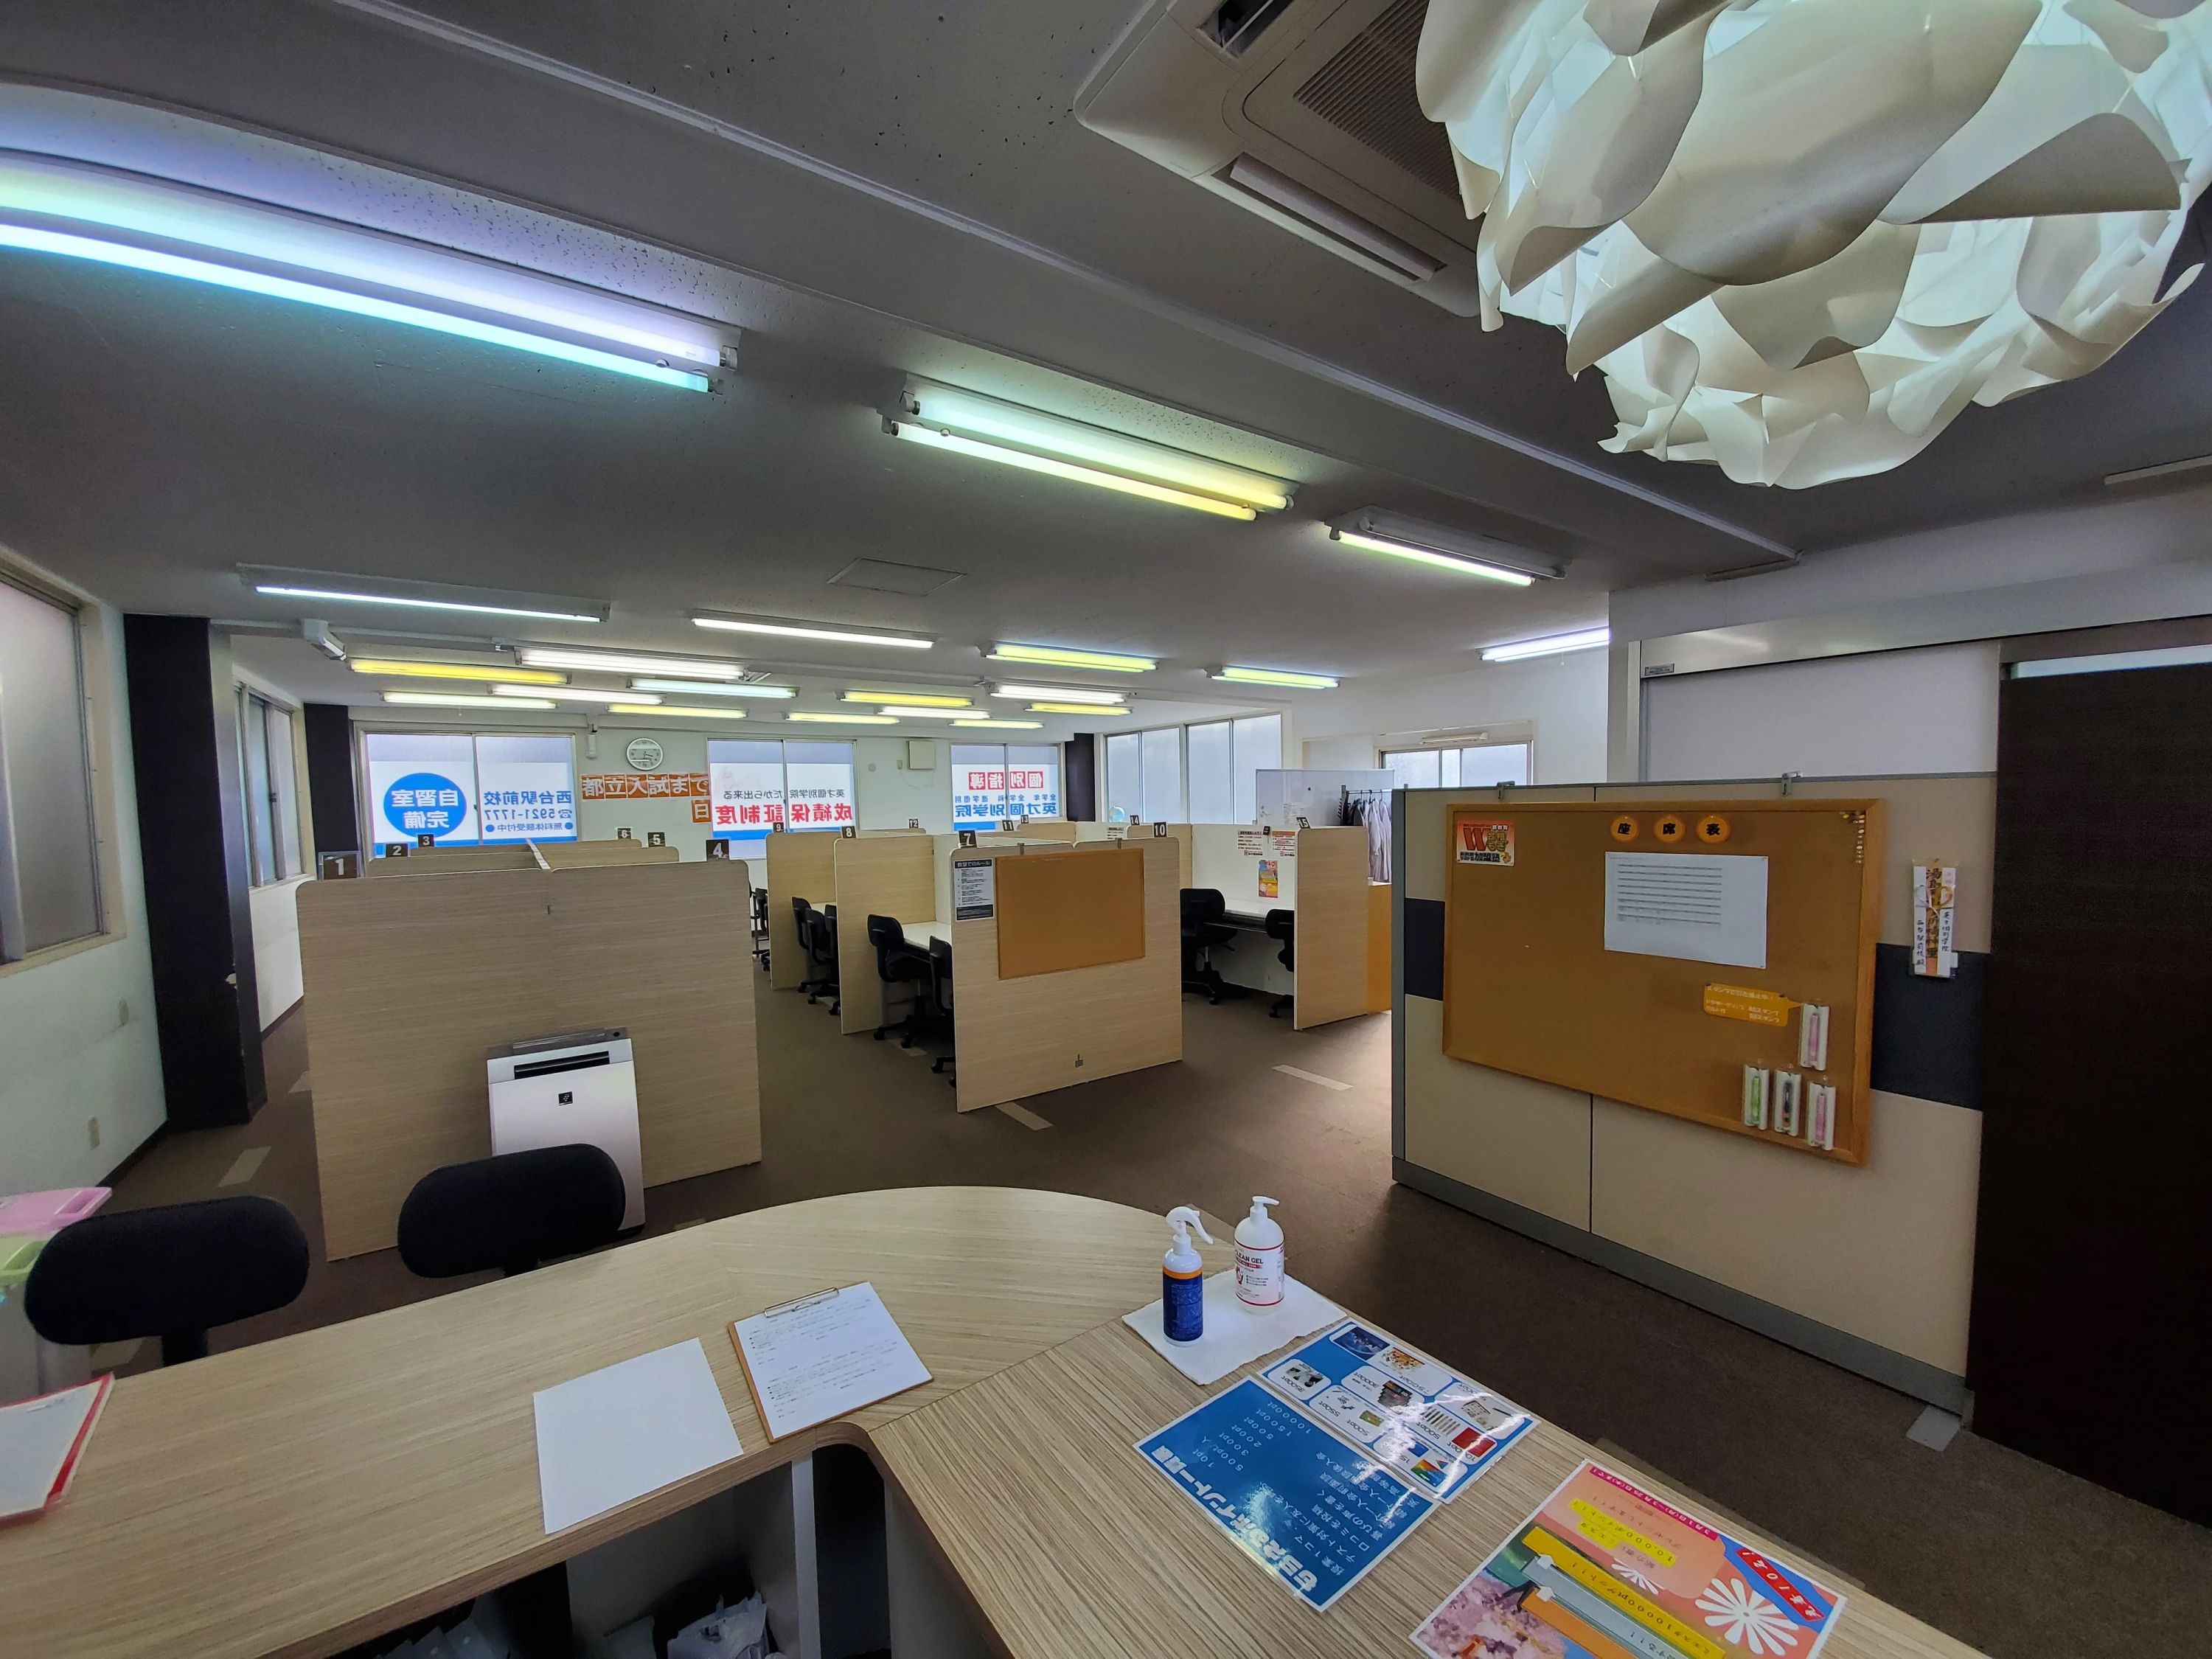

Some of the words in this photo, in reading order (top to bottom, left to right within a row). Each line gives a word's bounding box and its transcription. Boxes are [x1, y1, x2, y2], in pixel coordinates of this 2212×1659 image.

[582, 776, 709, 797] 都立入試まで
[695, 804, 709, 819] 日
[1004, 821, 1012, 830] 11
[1130, 816, 1139, 825] 14
[1298, 818, 1308, 827] 15
[622, 830, 627, 838] 6
[846, 827, 852, 837] 8
[1155, 824, 1165, 836] 10
[422, 836, 430, 846] 3
[653, 834, 661, 845] 5
[963, 832, 972, 846] 7
[392, 846, 402, 856] 2
[712, 842, 723, 858] 4
[335, 859, 345, 876] 1
[1254, 1408, 1294, 1436] 1500pt
[1265, 1400, 1314, 1434] 10000pt
[1242, 1416, 1276, 1439] 500pt
[1344, 1419, 1370, 1436] 500pt
[1230, 1424, 1262, 1447] 200pt
[1217, 1431, 1250, 1456] 300pt
[1315, 1488, 1385, 1541] 喜びの声を書く
[1310, 1503, 1371, 1551] 口コミを投稿
